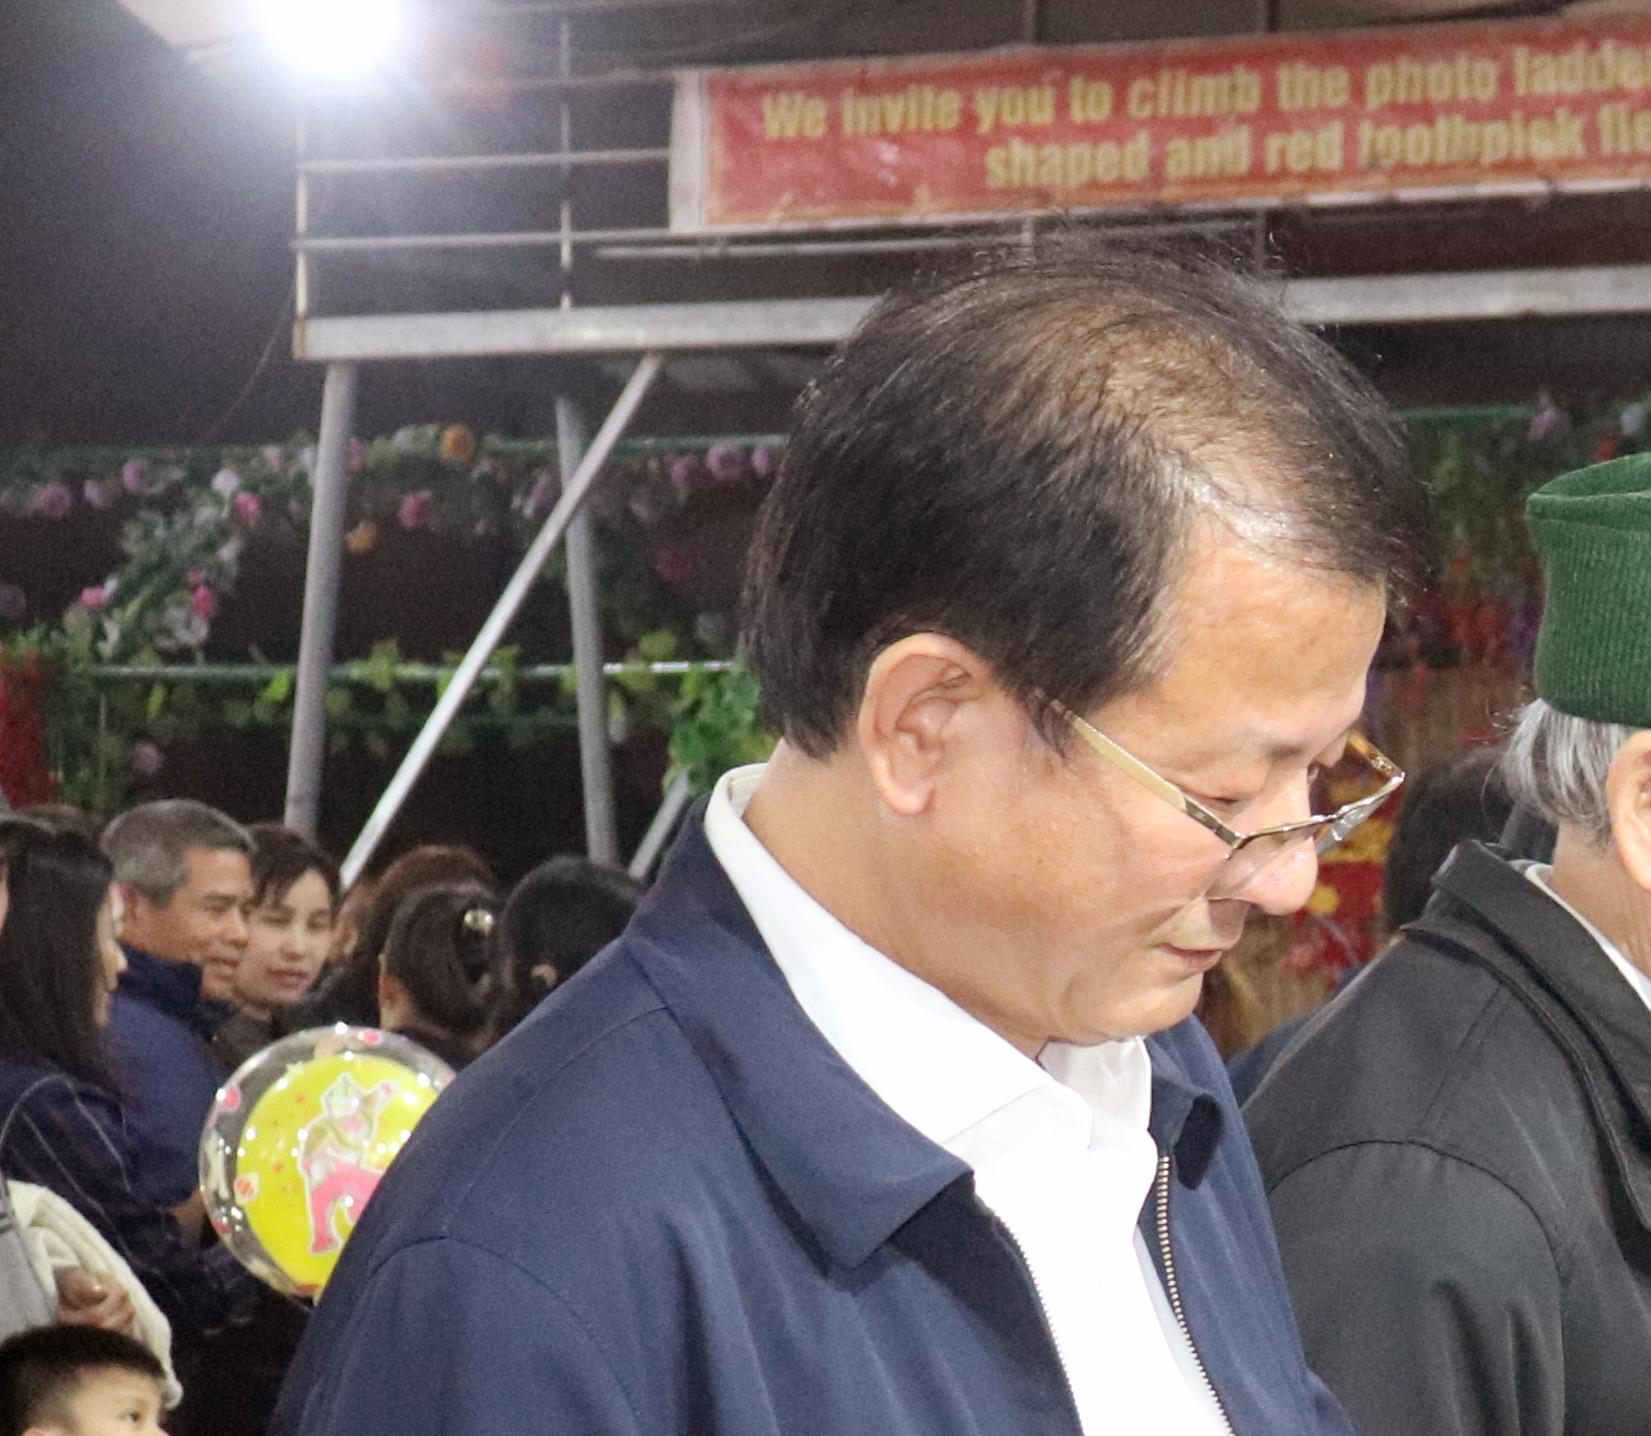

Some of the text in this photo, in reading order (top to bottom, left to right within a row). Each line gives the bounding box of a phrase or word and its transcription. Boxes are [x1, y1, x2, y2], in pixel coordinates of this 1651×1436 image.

[762, 93, 827, 141] We
[842, 82, 960, 135] invite
[974, 84, 1056, 136] you
[1069, 73, 1113, 125] to
[1128, 63, 1260, 120] climb
[1277, 61, 1350, 115] the
[1364, 50, 1499, 113] photo
[984, 127, 1151, 190] shaped
[1165, 121, 1251, 180] and
[1265, 119, 1344, 177] red
[1357, 102, 1583, 169] toothpick
